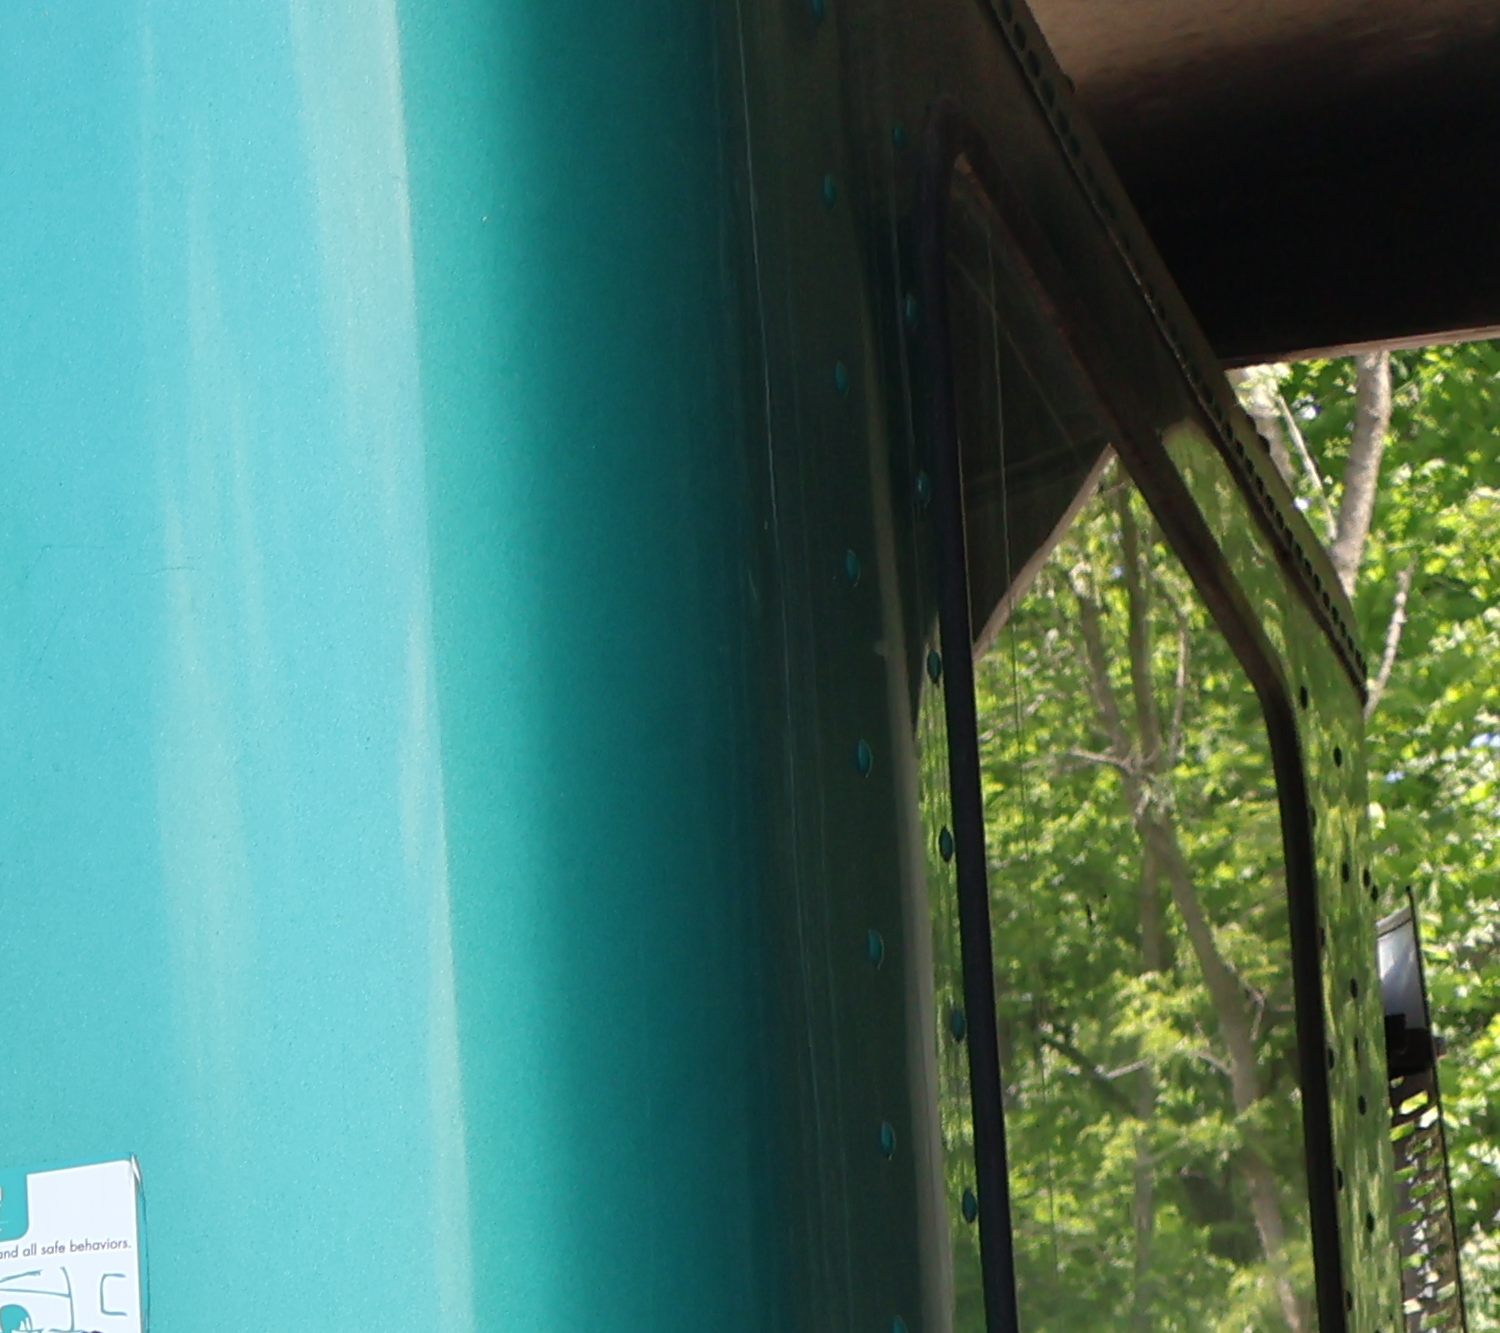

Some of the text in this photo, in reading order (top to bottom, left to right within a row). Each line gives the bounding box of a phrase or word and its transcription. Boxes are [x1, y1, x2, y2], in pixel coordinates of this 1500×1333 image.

[22, 1242, 38, 1257] all
[40, 1240, 67, 1255] safe
[69, 1236, 133, 1254] behaviors.
